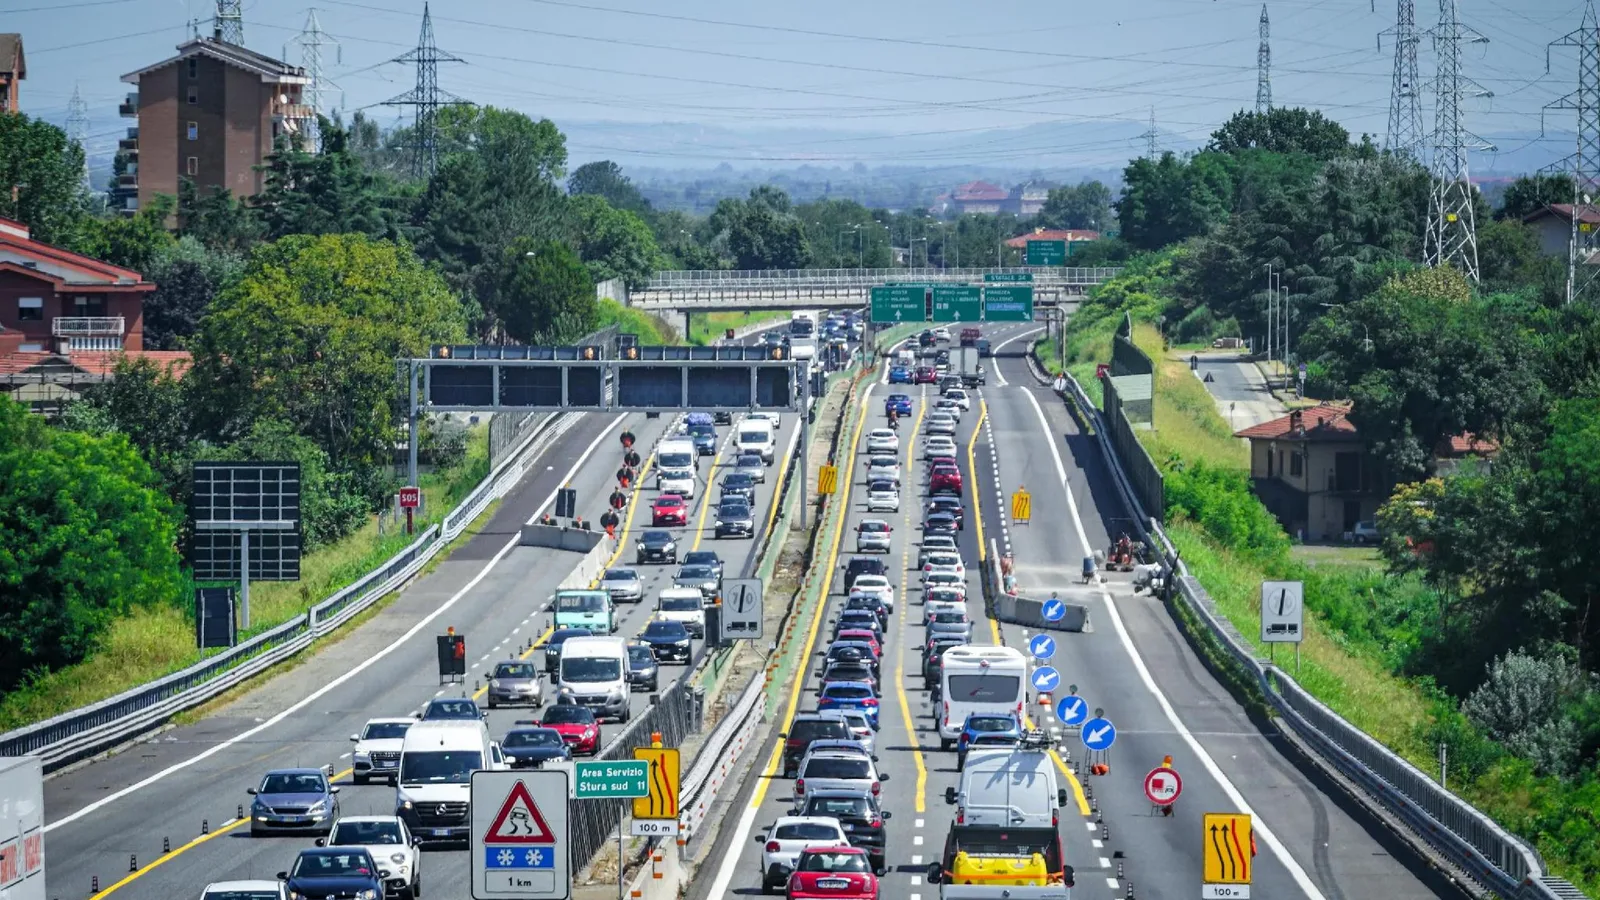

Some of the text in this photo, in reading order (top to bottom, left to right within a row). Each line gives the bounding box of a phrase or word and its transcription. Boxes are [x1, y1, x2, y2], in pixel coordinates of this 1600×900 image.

[402, 493, 417, 502] SOS
[581, 767, 644, 778] Area Servizio
[579, 780, 646, 792] Stura sud 11
[639, 823, 658, 832] 100
[508, 876, 532, 887] 1 km
[1214, 887, 1231, 896] 100
